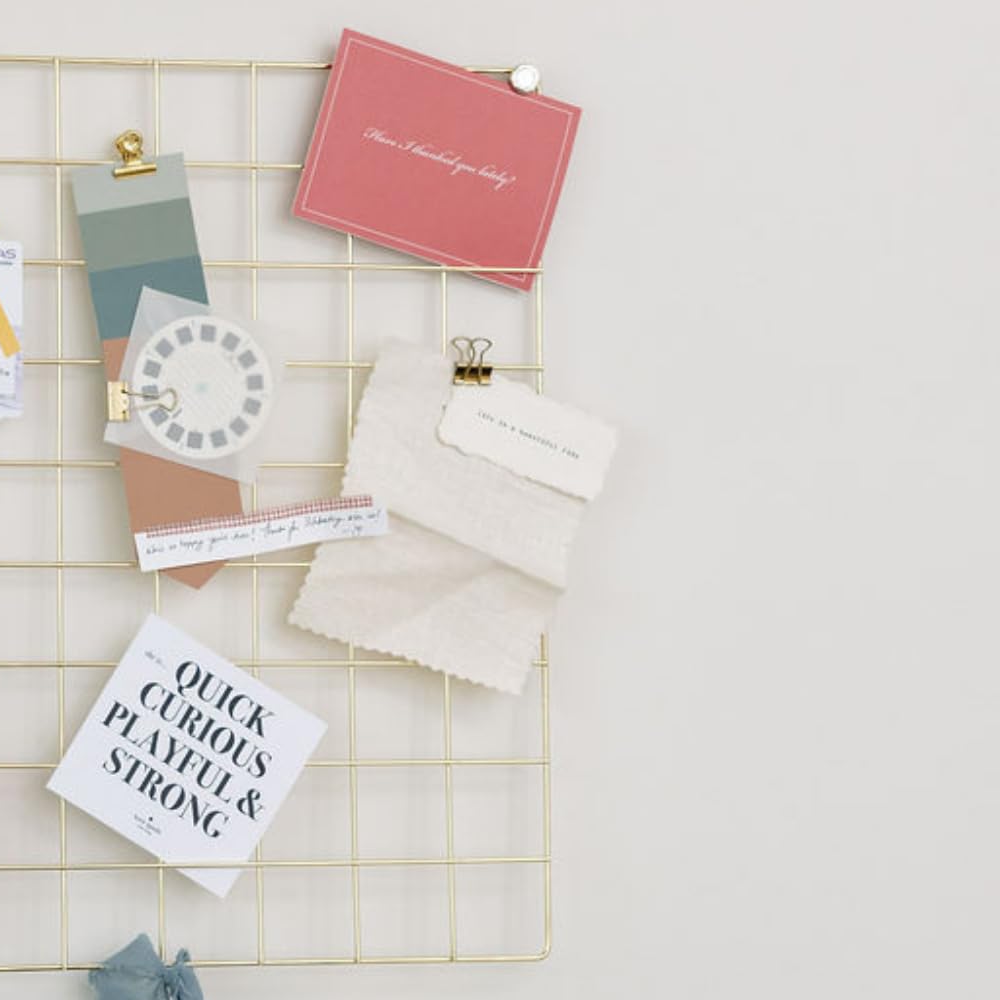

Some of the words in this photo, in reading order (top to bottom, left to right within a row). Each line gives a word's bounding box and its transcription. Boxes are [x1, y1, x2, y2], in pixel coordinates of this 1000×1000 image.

[363, 128, 396, 146] Have
[450, 162, 476, 175] you
[139, 681, 273, 779] CURIOUS
[175, 660, 277, 738] QUICK
[101, 700, 235, 804] PLAYFUL
[236, 788, 267, 823] &
[102, 747, 230, 839] STRONG
